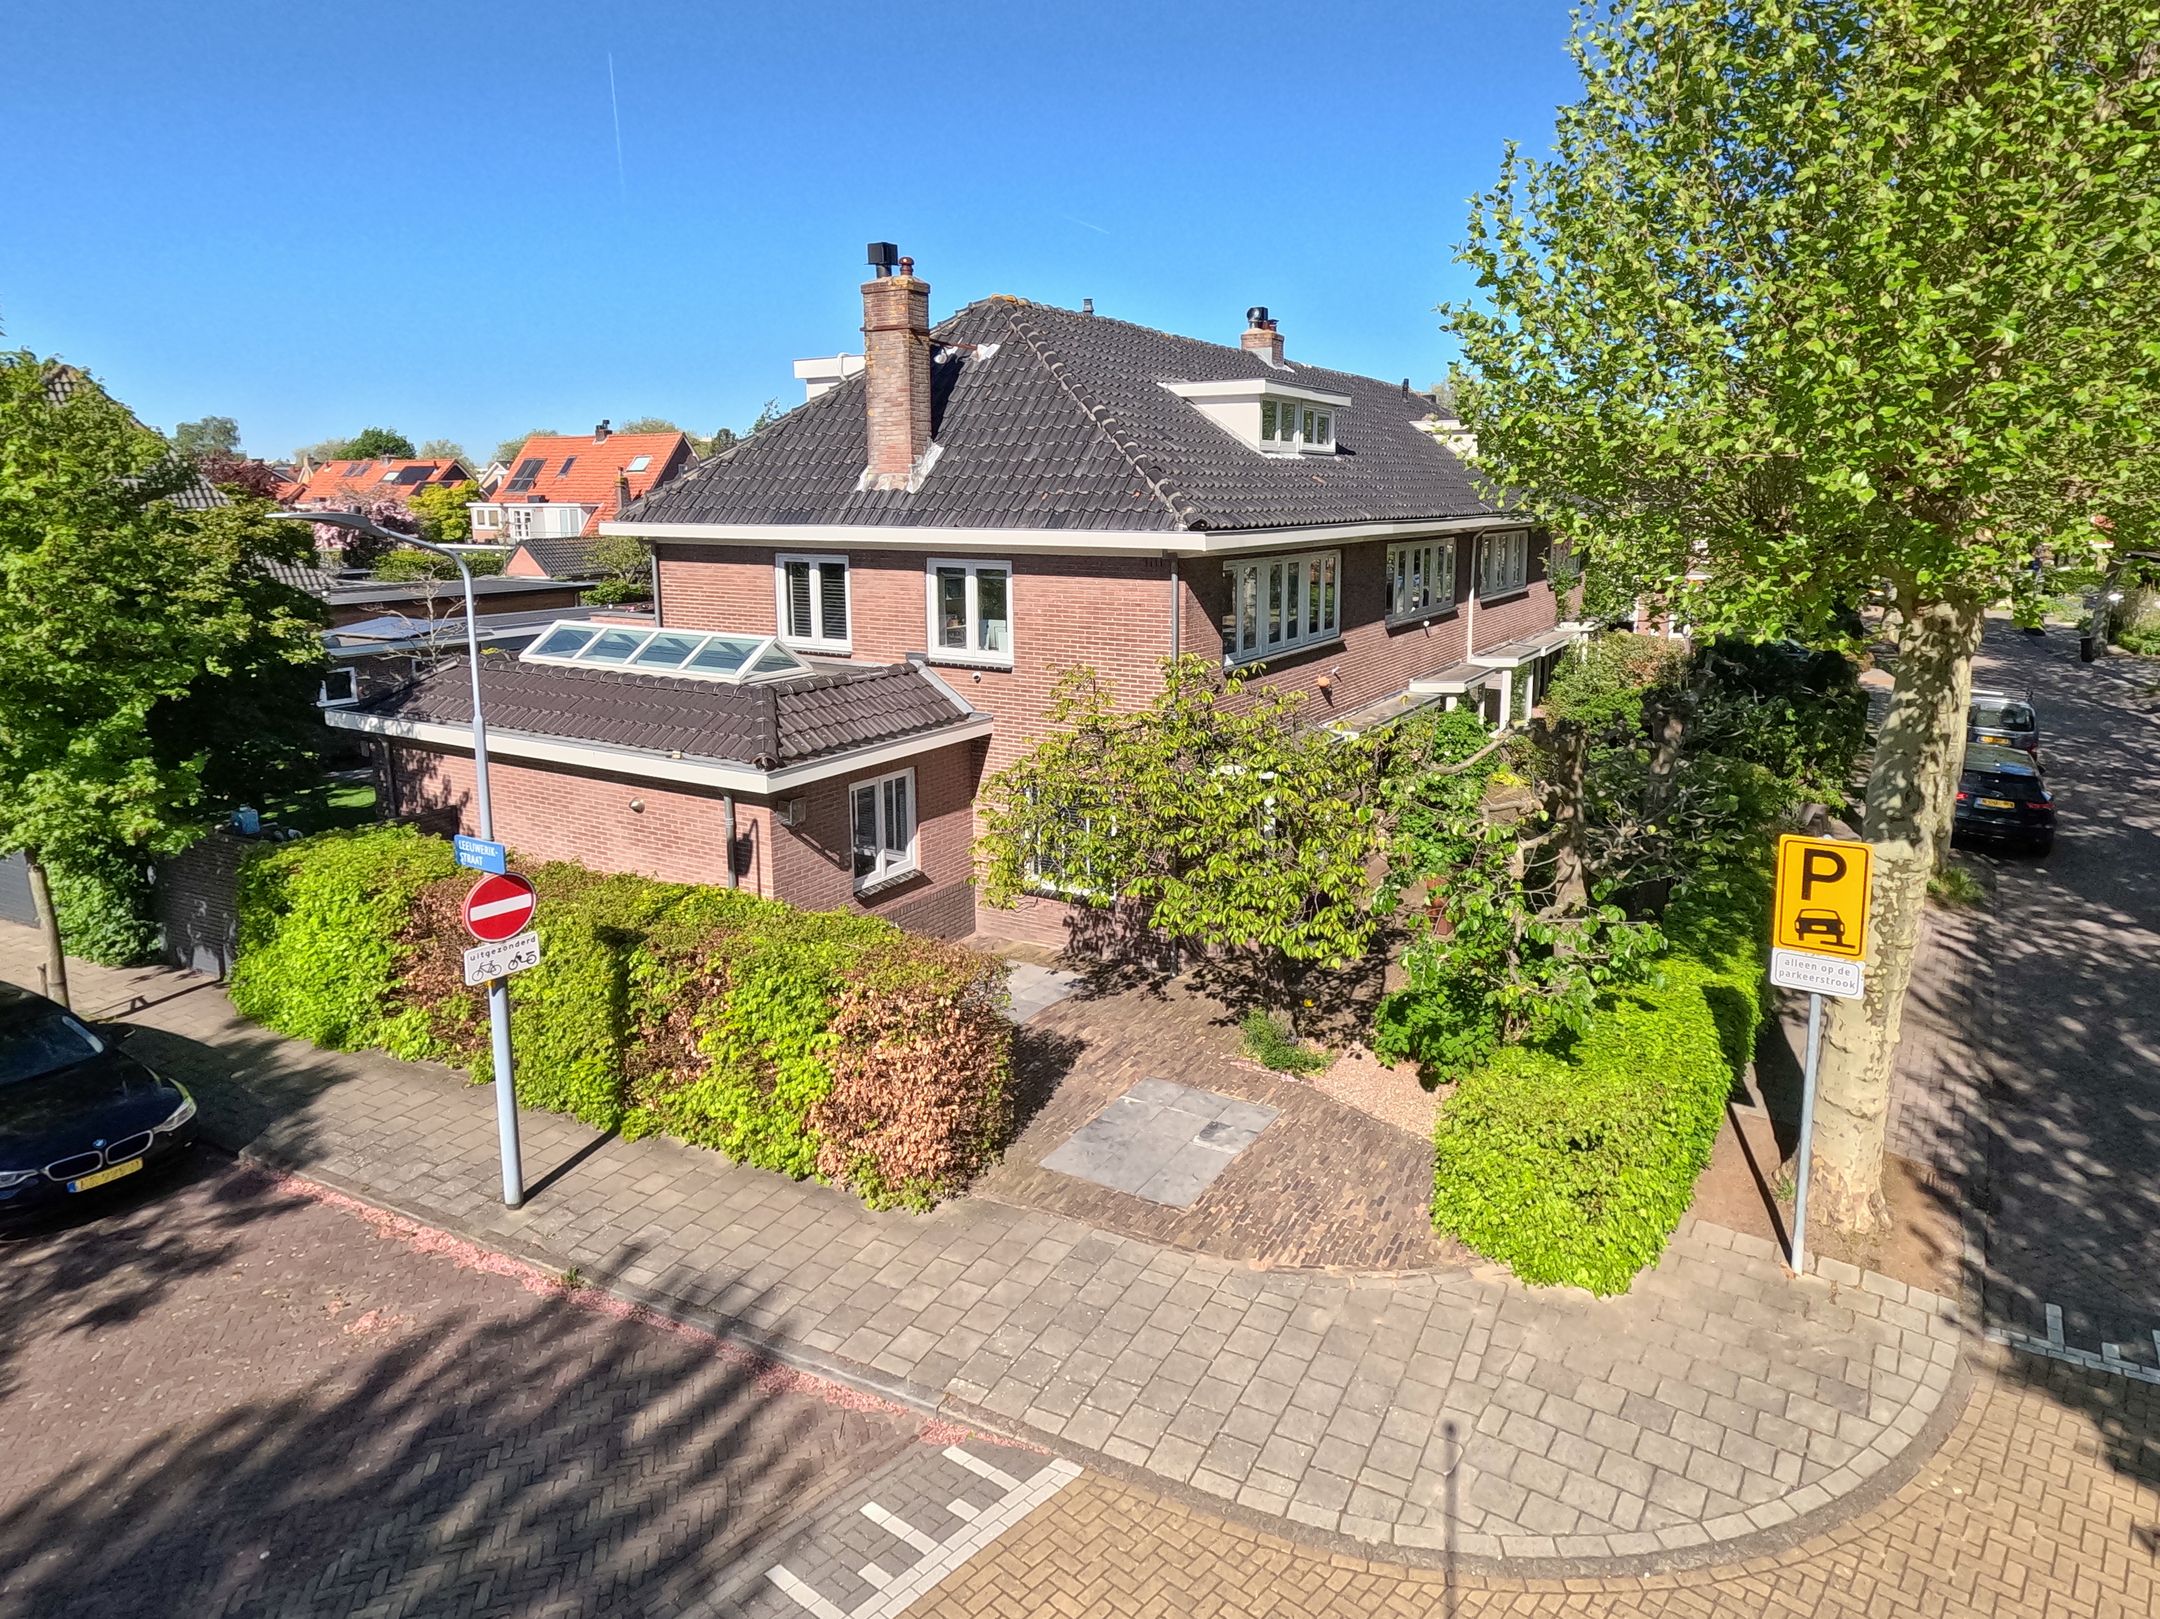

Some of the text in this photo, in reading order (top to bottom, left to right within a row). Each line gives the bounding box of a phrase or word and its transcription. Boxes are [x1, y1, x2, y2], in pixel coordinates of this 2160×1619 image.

[460, 852, 483, 866] STRAAT
[1801, 848, 1847, 900] P
[470, 936, 536, 961] uitgezonderd
[1784, 959, 1851, 976] alleen op de
[1779, 970, 1856, 989] parkeerstrook
